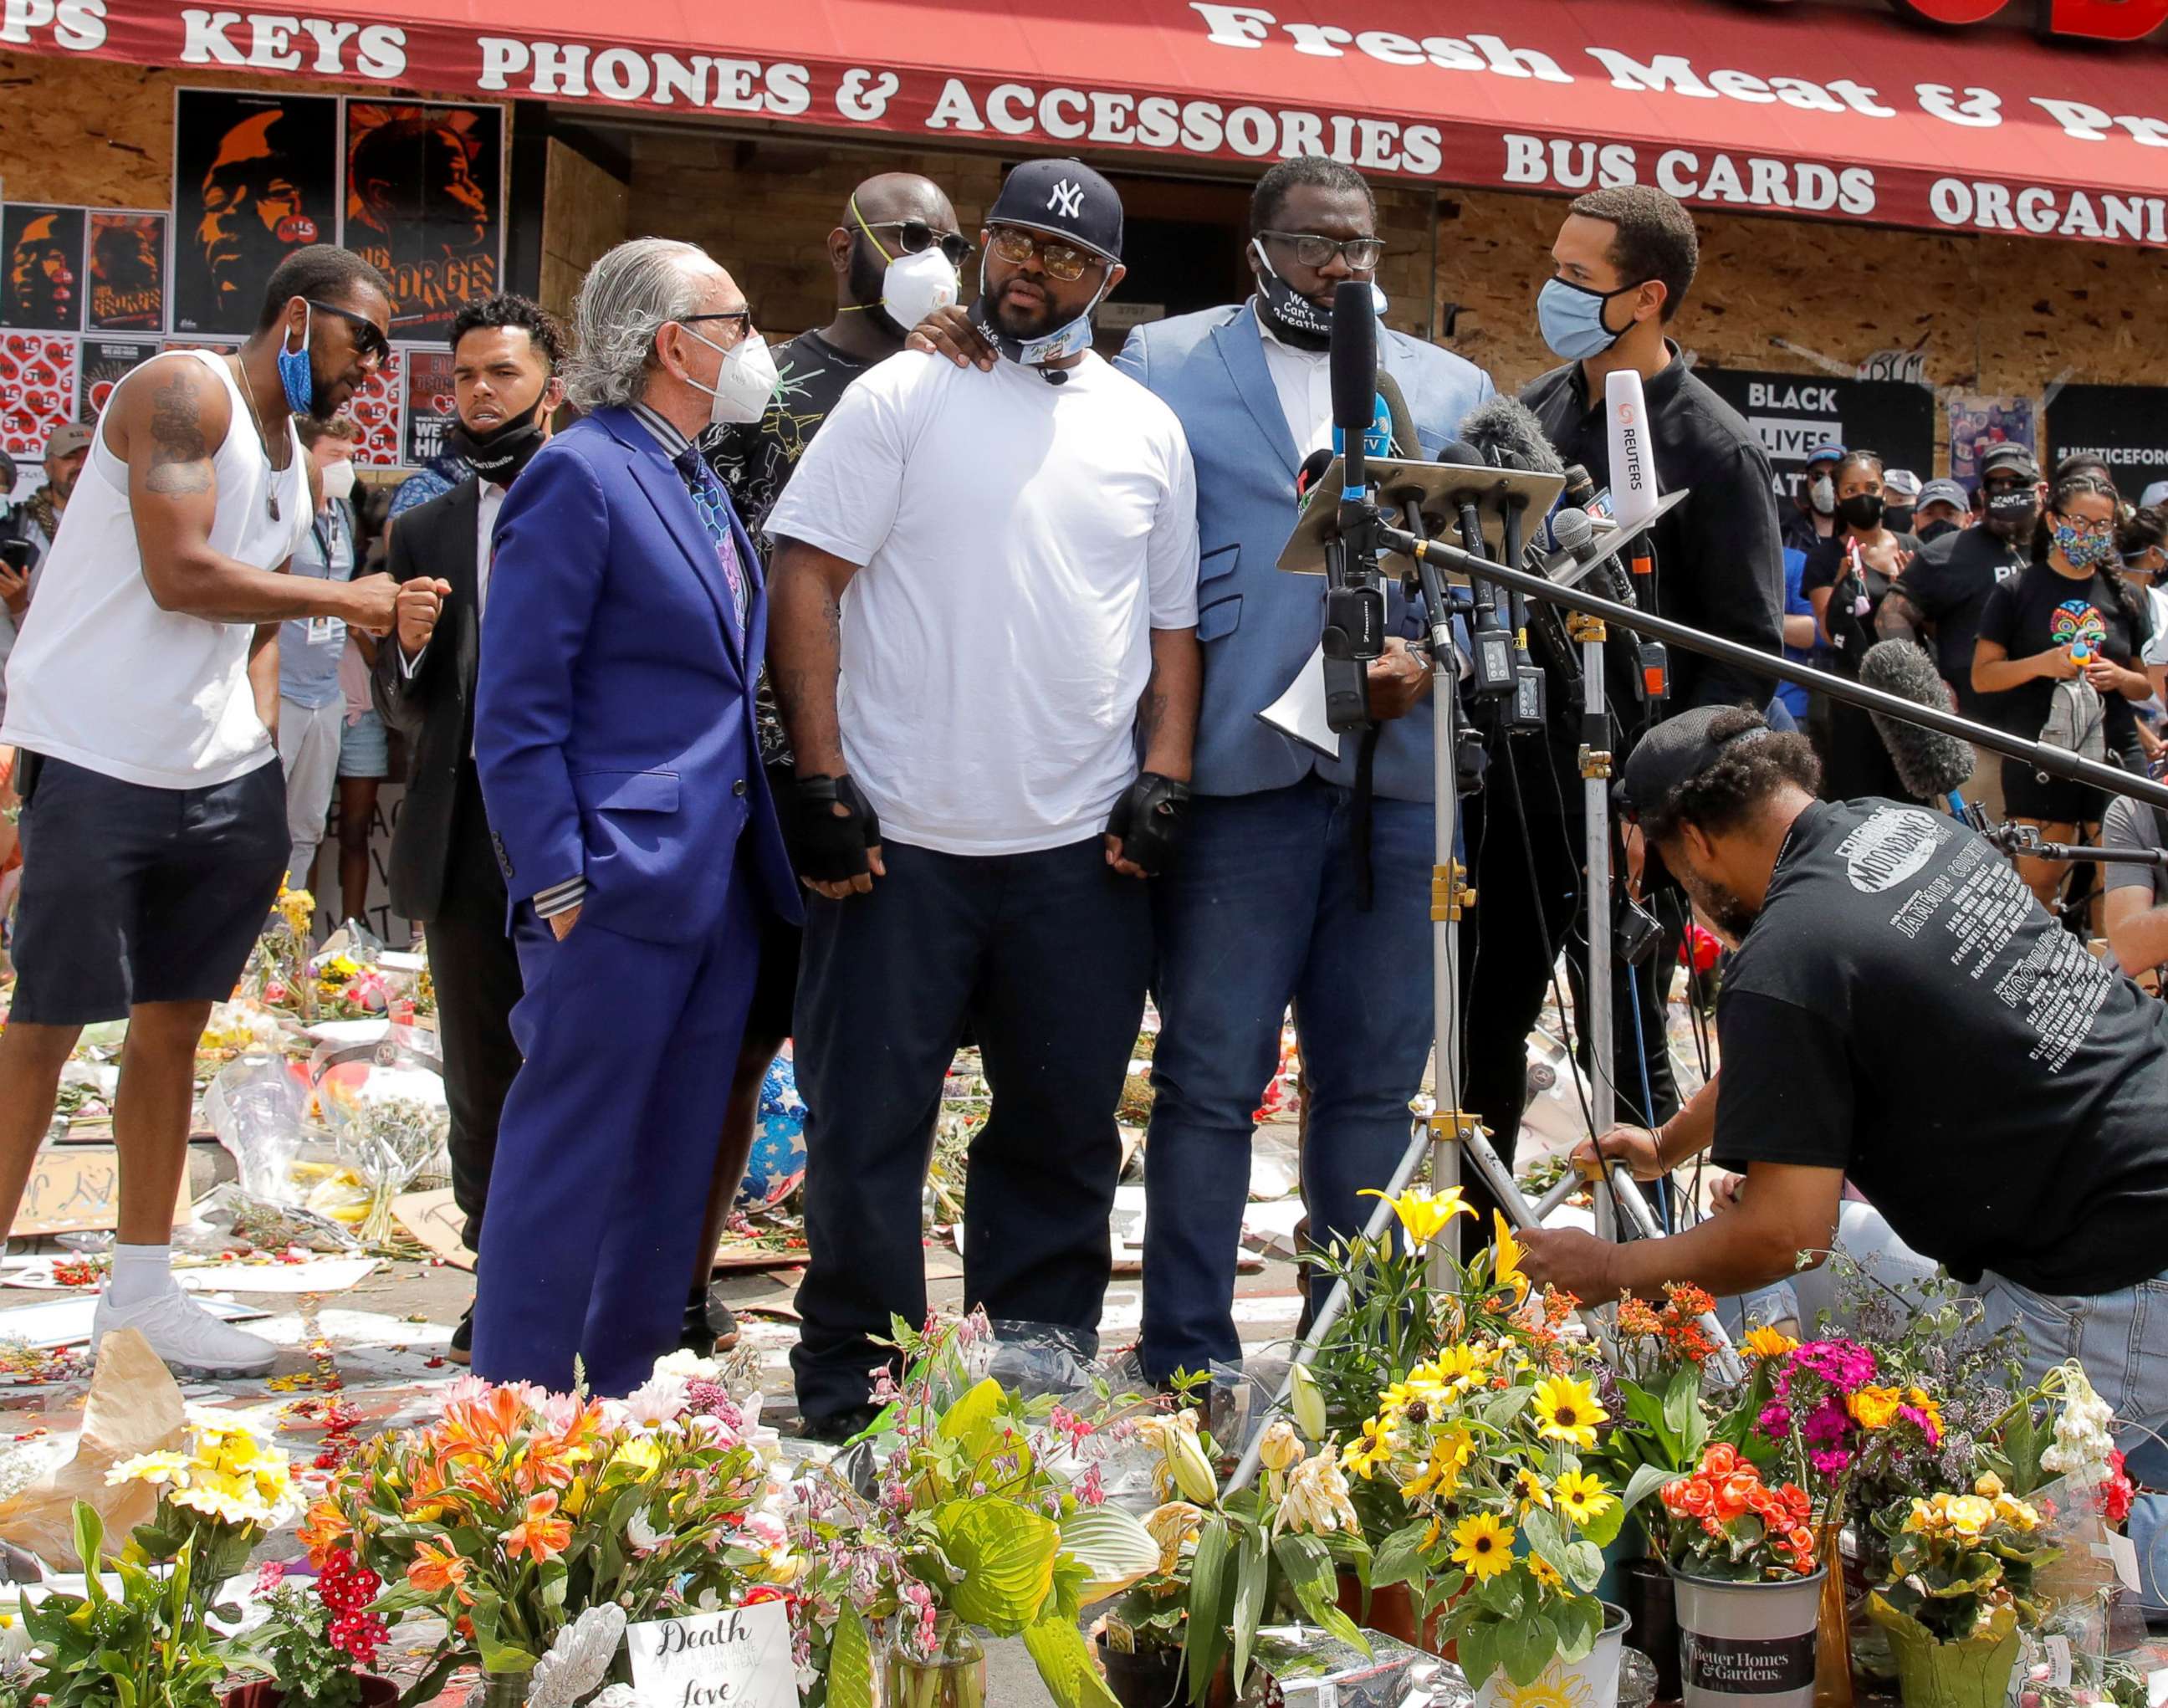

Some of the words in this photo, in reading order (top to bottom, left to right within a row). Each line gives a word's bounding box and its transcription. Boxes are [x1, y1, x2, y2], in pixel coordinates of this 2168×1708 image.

[1187, 1, 1574, 84] Fresh
[1583, 46, 1896, 119] Meat
[1915, 82, 2002, 128] &
[0, 0, 109, 52] PS
[180, 9, 407, 79] KEYS
[477, 36, 811, 115] PHONES
[835, 67, 900, 122] &
[925, 78, 1444, 175] ACCESSORIES
[1503, 133, 1638, 189] BUS
[1656, 150, 1877, 216] CARDS
[1929, 176, 2168, 243] ORGANI
[1046, 177, 1085, 219] NY
[1283, 301, 1316, 321] Can't
[1289, 290, 1310, 309] We
[1869, 352, 1924, 384] BLM
[1748, 382, 1838, 412] BLACK
[416, 423, 441, 437] WE
[1623, 428, 1642, 491] REUTERS
[1850, 812, 1936, 888] MOONDANCE
[1944, 910, 1965, 933] JAKE
[1954, 915, 1977, 939] CHRIS
[1950, 923, 1986, 965] FAREWELL
[1976, 938, 1990, 952] 32
[1969, 949, 1996, 980] ROGER
[2025, 976, 2049, 1005] BOSTON
[2062, 1010, 2084, 1037] QUEEN
[656, 1609, 753, 1656] Death
[1694, 1647, 1735, 1666] Better
[1737, 1652, 1789, 1667] Homes
[678, 1679, 740, 1708] Love
